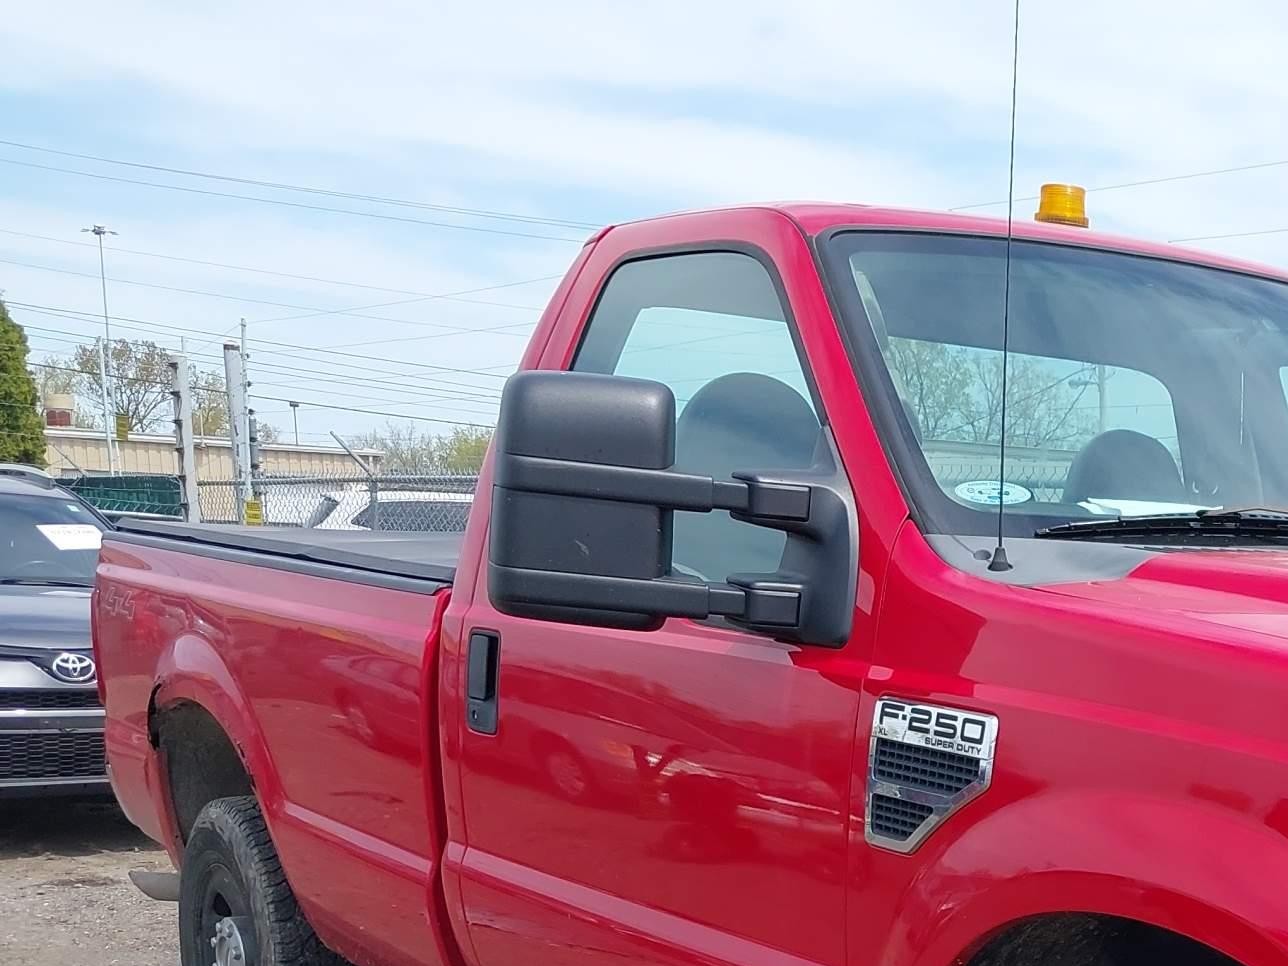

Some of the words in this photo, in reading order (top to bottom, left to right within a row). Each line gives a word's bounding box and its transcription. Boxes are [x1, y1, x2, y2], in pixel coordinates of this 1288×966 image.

[878, 727, 888, 736] XL
[879, 702, 986, 746] F-250
[924, 737, 955, 750] SUPER
[956, 743, 982, 757] DUTY
